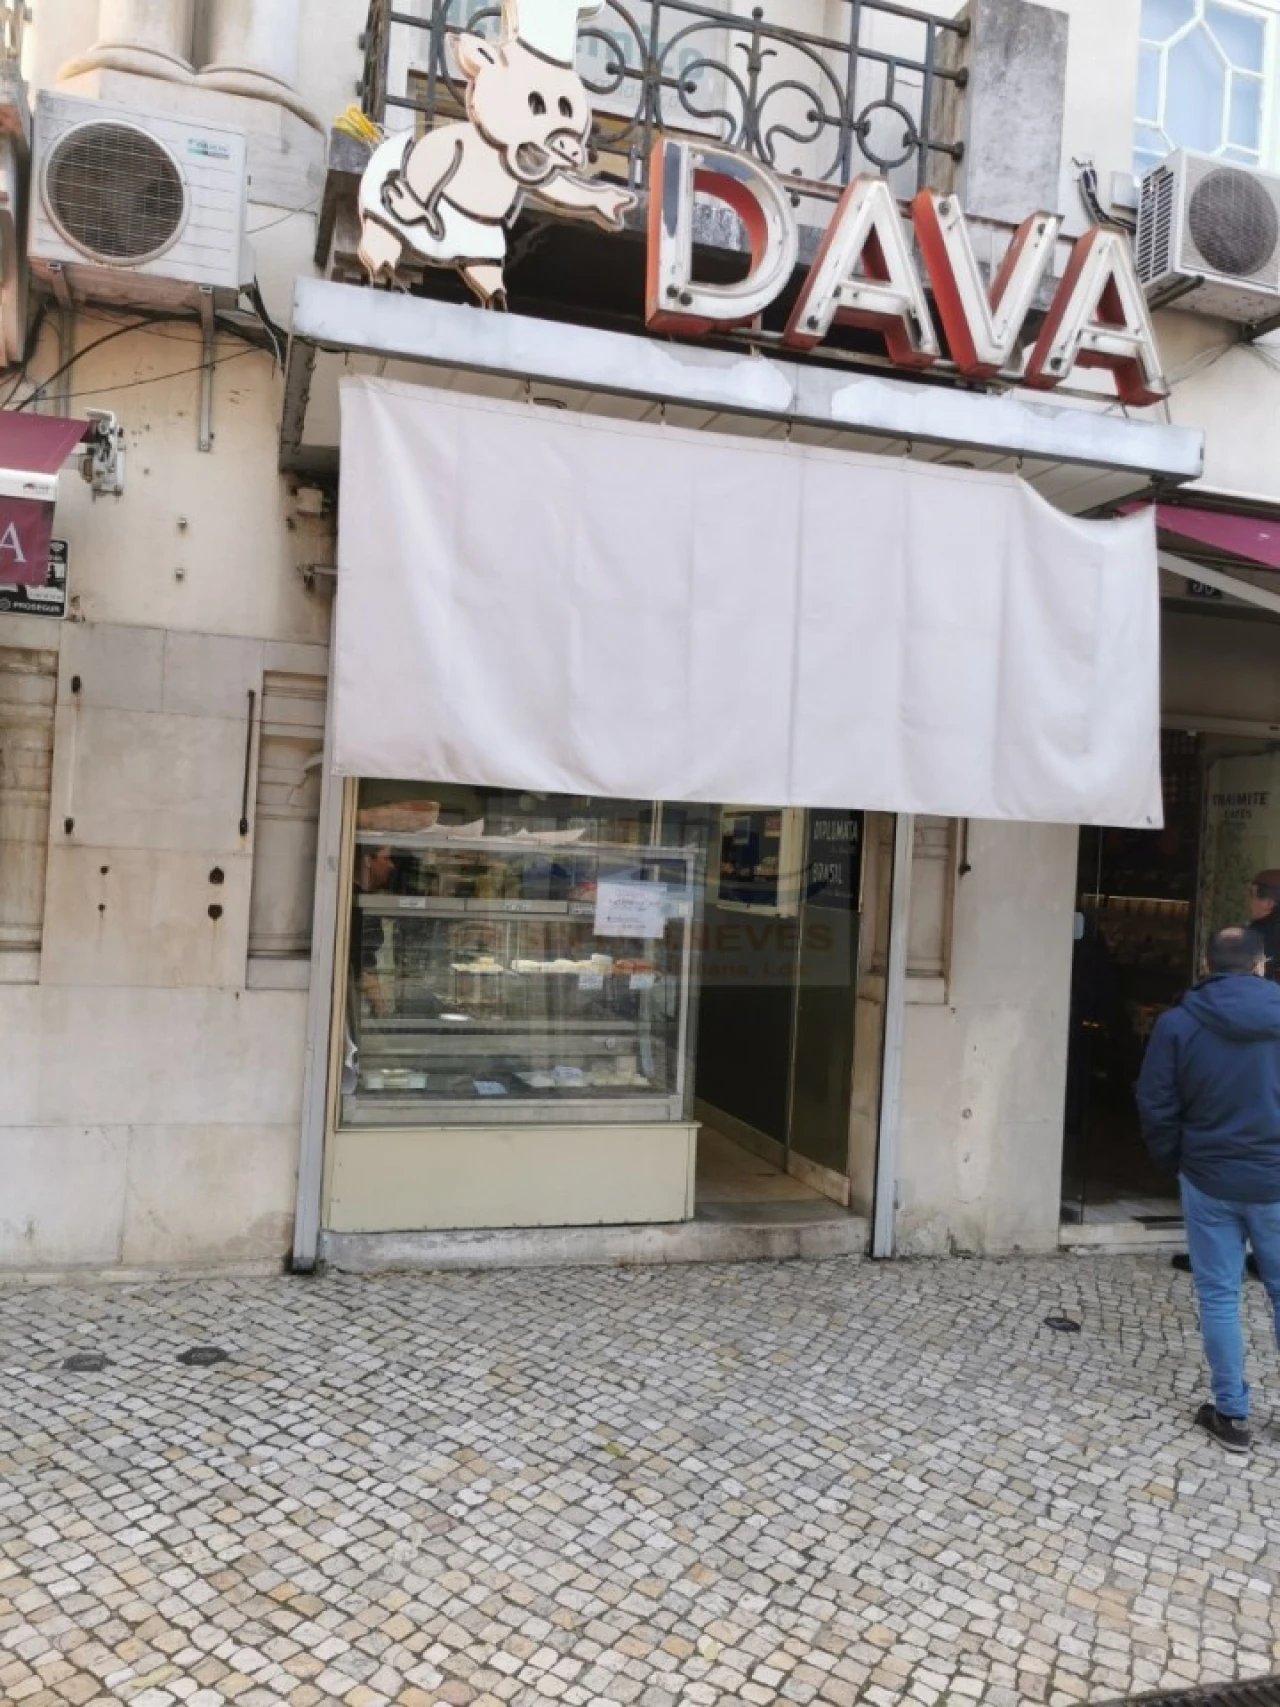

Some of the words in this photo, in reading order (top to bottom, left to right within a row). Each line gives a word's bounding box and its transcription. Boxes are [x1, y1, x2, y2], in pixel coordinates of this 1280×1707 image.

[646, 133, 1168, 406] DAVA
[13, 602, 61, 613] PROSEGUR
[812, 862, 843, 884] BRASIL
